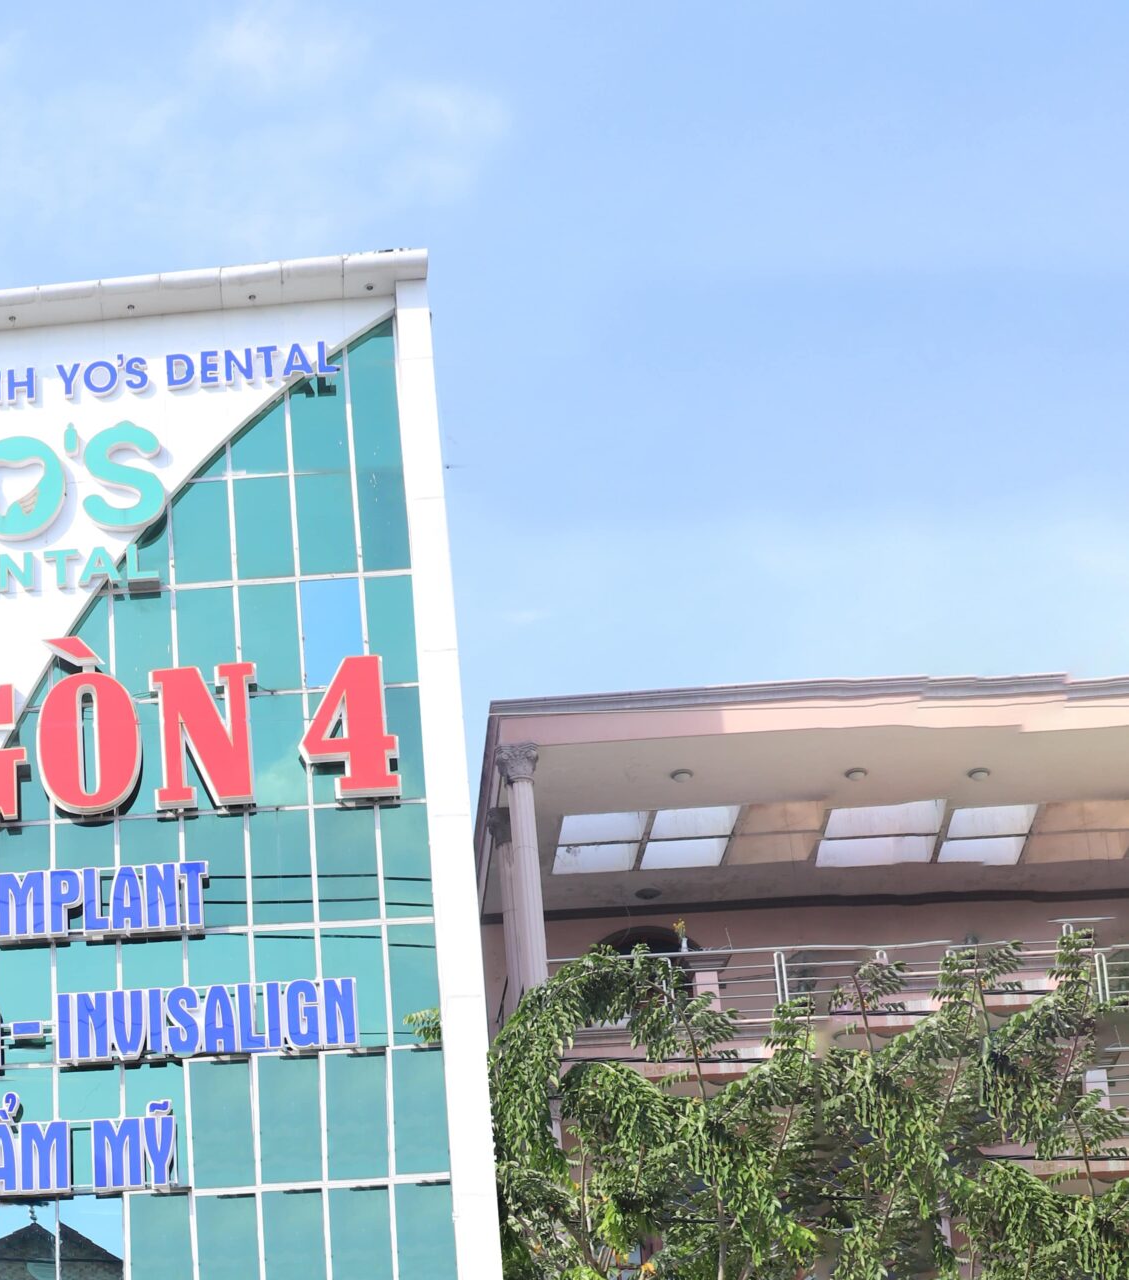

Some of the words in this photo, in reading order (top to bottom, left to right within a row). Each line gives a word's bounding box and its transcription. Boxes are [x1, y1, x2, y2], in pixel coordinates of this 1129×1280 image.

[56, 354, 150, 398] YO'S
[165, 341, 341, 390] DENTAL
[299, 655, 401, 800] 4
[55, 976, 358, 1065] INVISALIGN
[91, 1098, 178, 1191] MỸ
